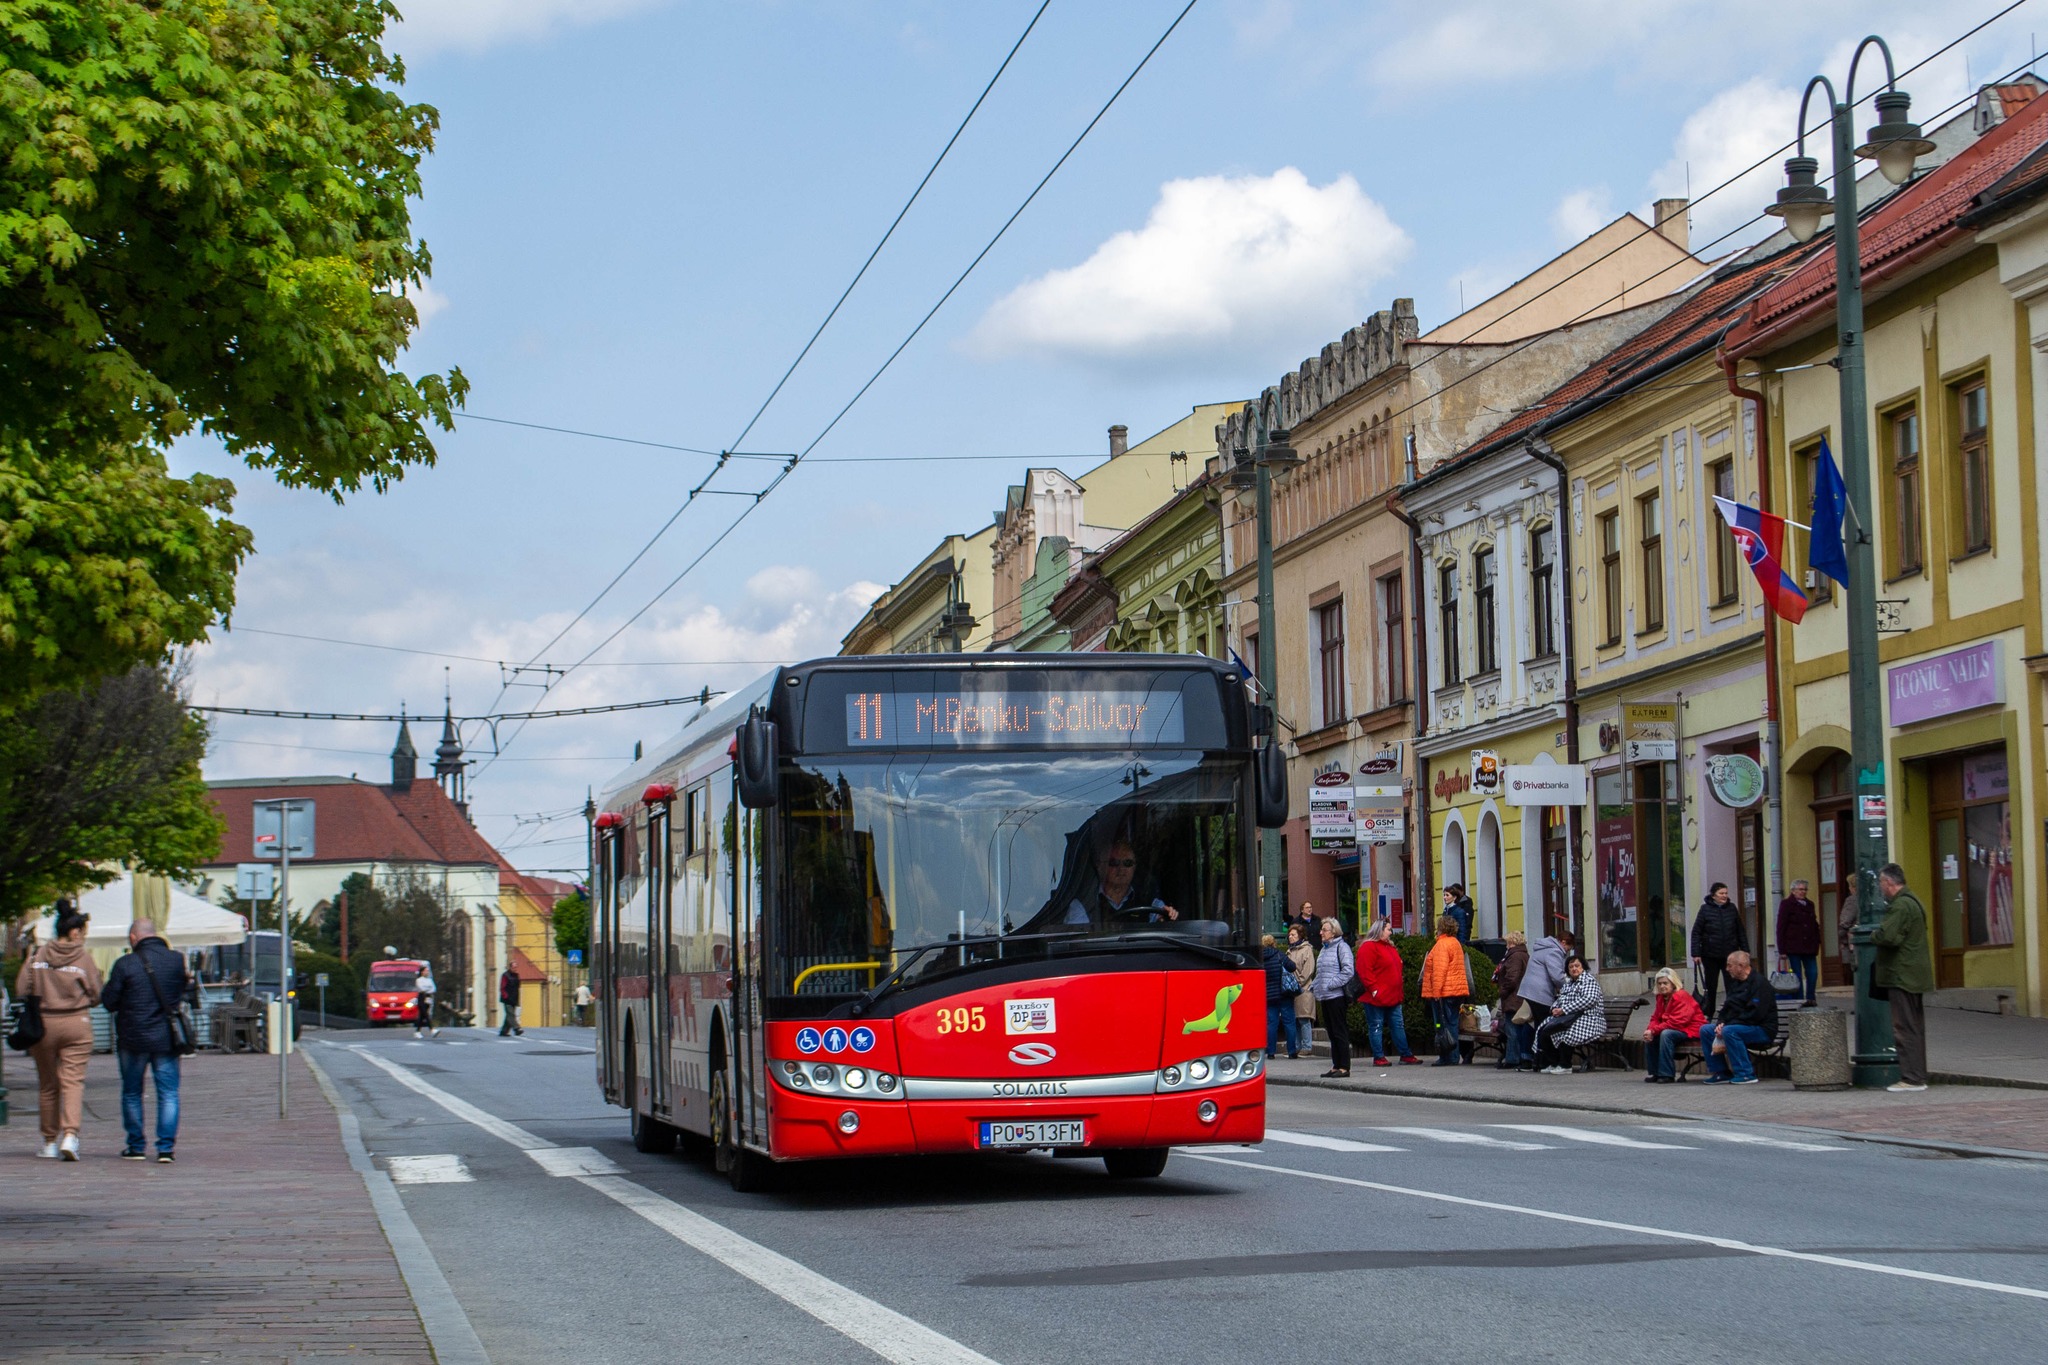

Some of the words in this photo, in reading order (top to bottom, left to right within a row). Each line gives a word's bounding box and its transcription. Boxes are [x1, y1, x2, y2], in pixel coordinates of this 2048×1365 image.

[854, 693, 882, 739] 11
[1632, 709, 1667, 717] EXTREM
[1655, 747, 1664, 757] IN
[1478, 773, 1496, 782] kofola
[1523, 781, 1569, 790] Privatbanka
[1618, 847, 1635, 878] 5%
[1009, 1002, 1049, 1011] PREŠOV
[936, 1006, 986, 1034] 395
[1013, 1012, 1029, 1023] DP
[992, 1082, 1068, 1097] SOLARIS
